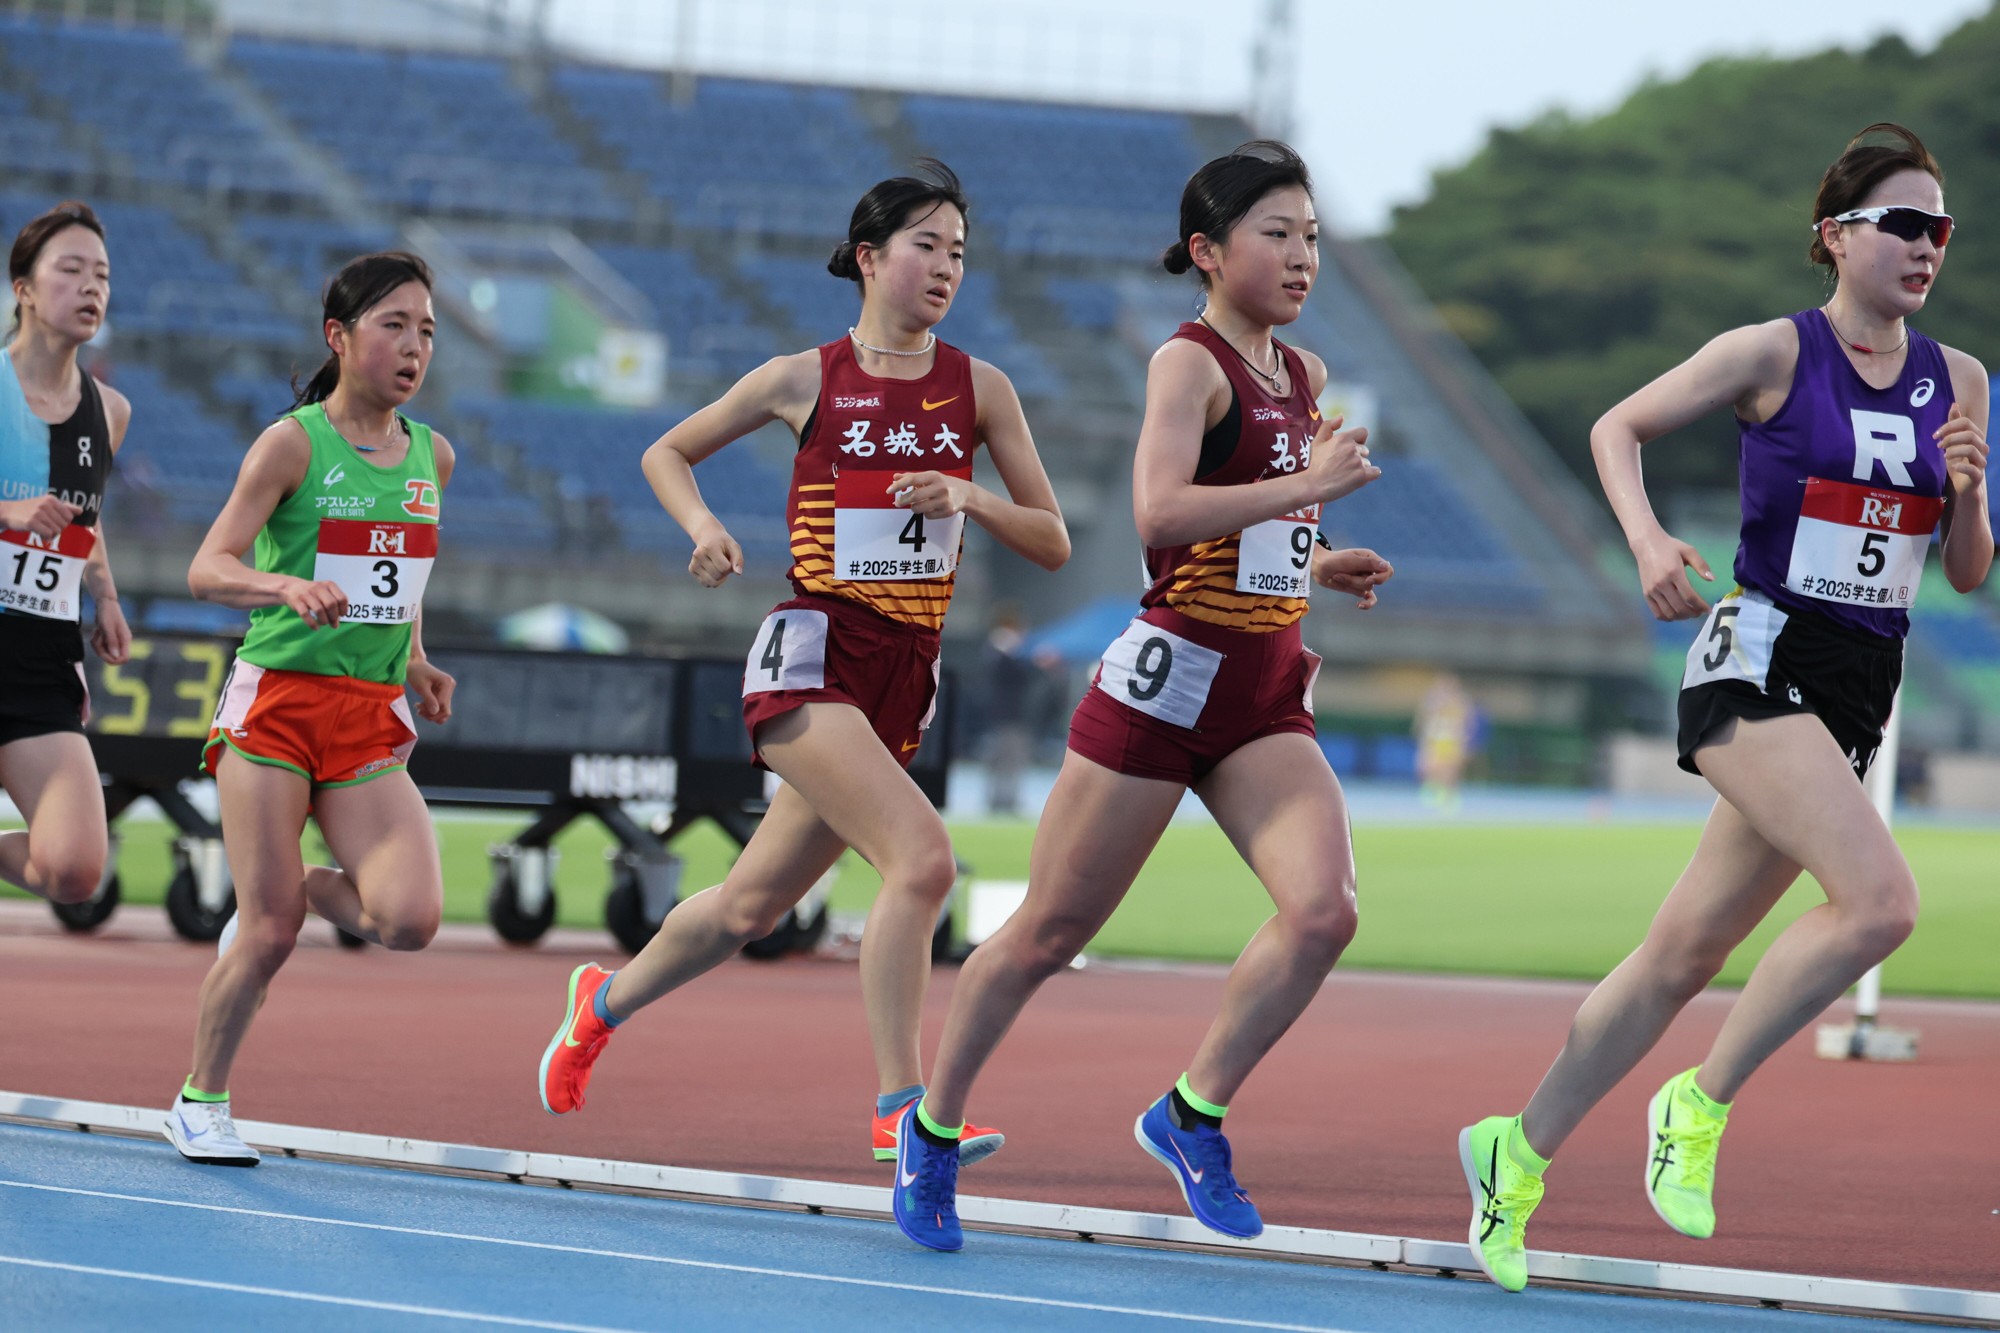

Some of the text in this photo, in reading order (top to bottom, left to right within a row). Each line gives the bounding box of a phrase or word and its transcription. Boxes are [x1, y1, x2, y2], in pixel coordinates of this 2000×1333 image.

[838, 420, 964, 459] 名城大
[1850, 408, 1917, 487] R
[315, 496, 376, 508] アスレスーツ
[328, 508, 365, 517] ATHLE SUITS
[898, 511, 927, 553] 4
[1291, 526, 1313, 570] 9
[13, 551, 63, 592] 15
[1857, 532, 1890, 578] 5
[371, 560, 399, 599] 3
[760, 618, 787, 682] 4
[1703, 606, 1741, 672] 5
[1127, 636, 1173, 701] 9
[570, 754, 678, 800] NISHI
